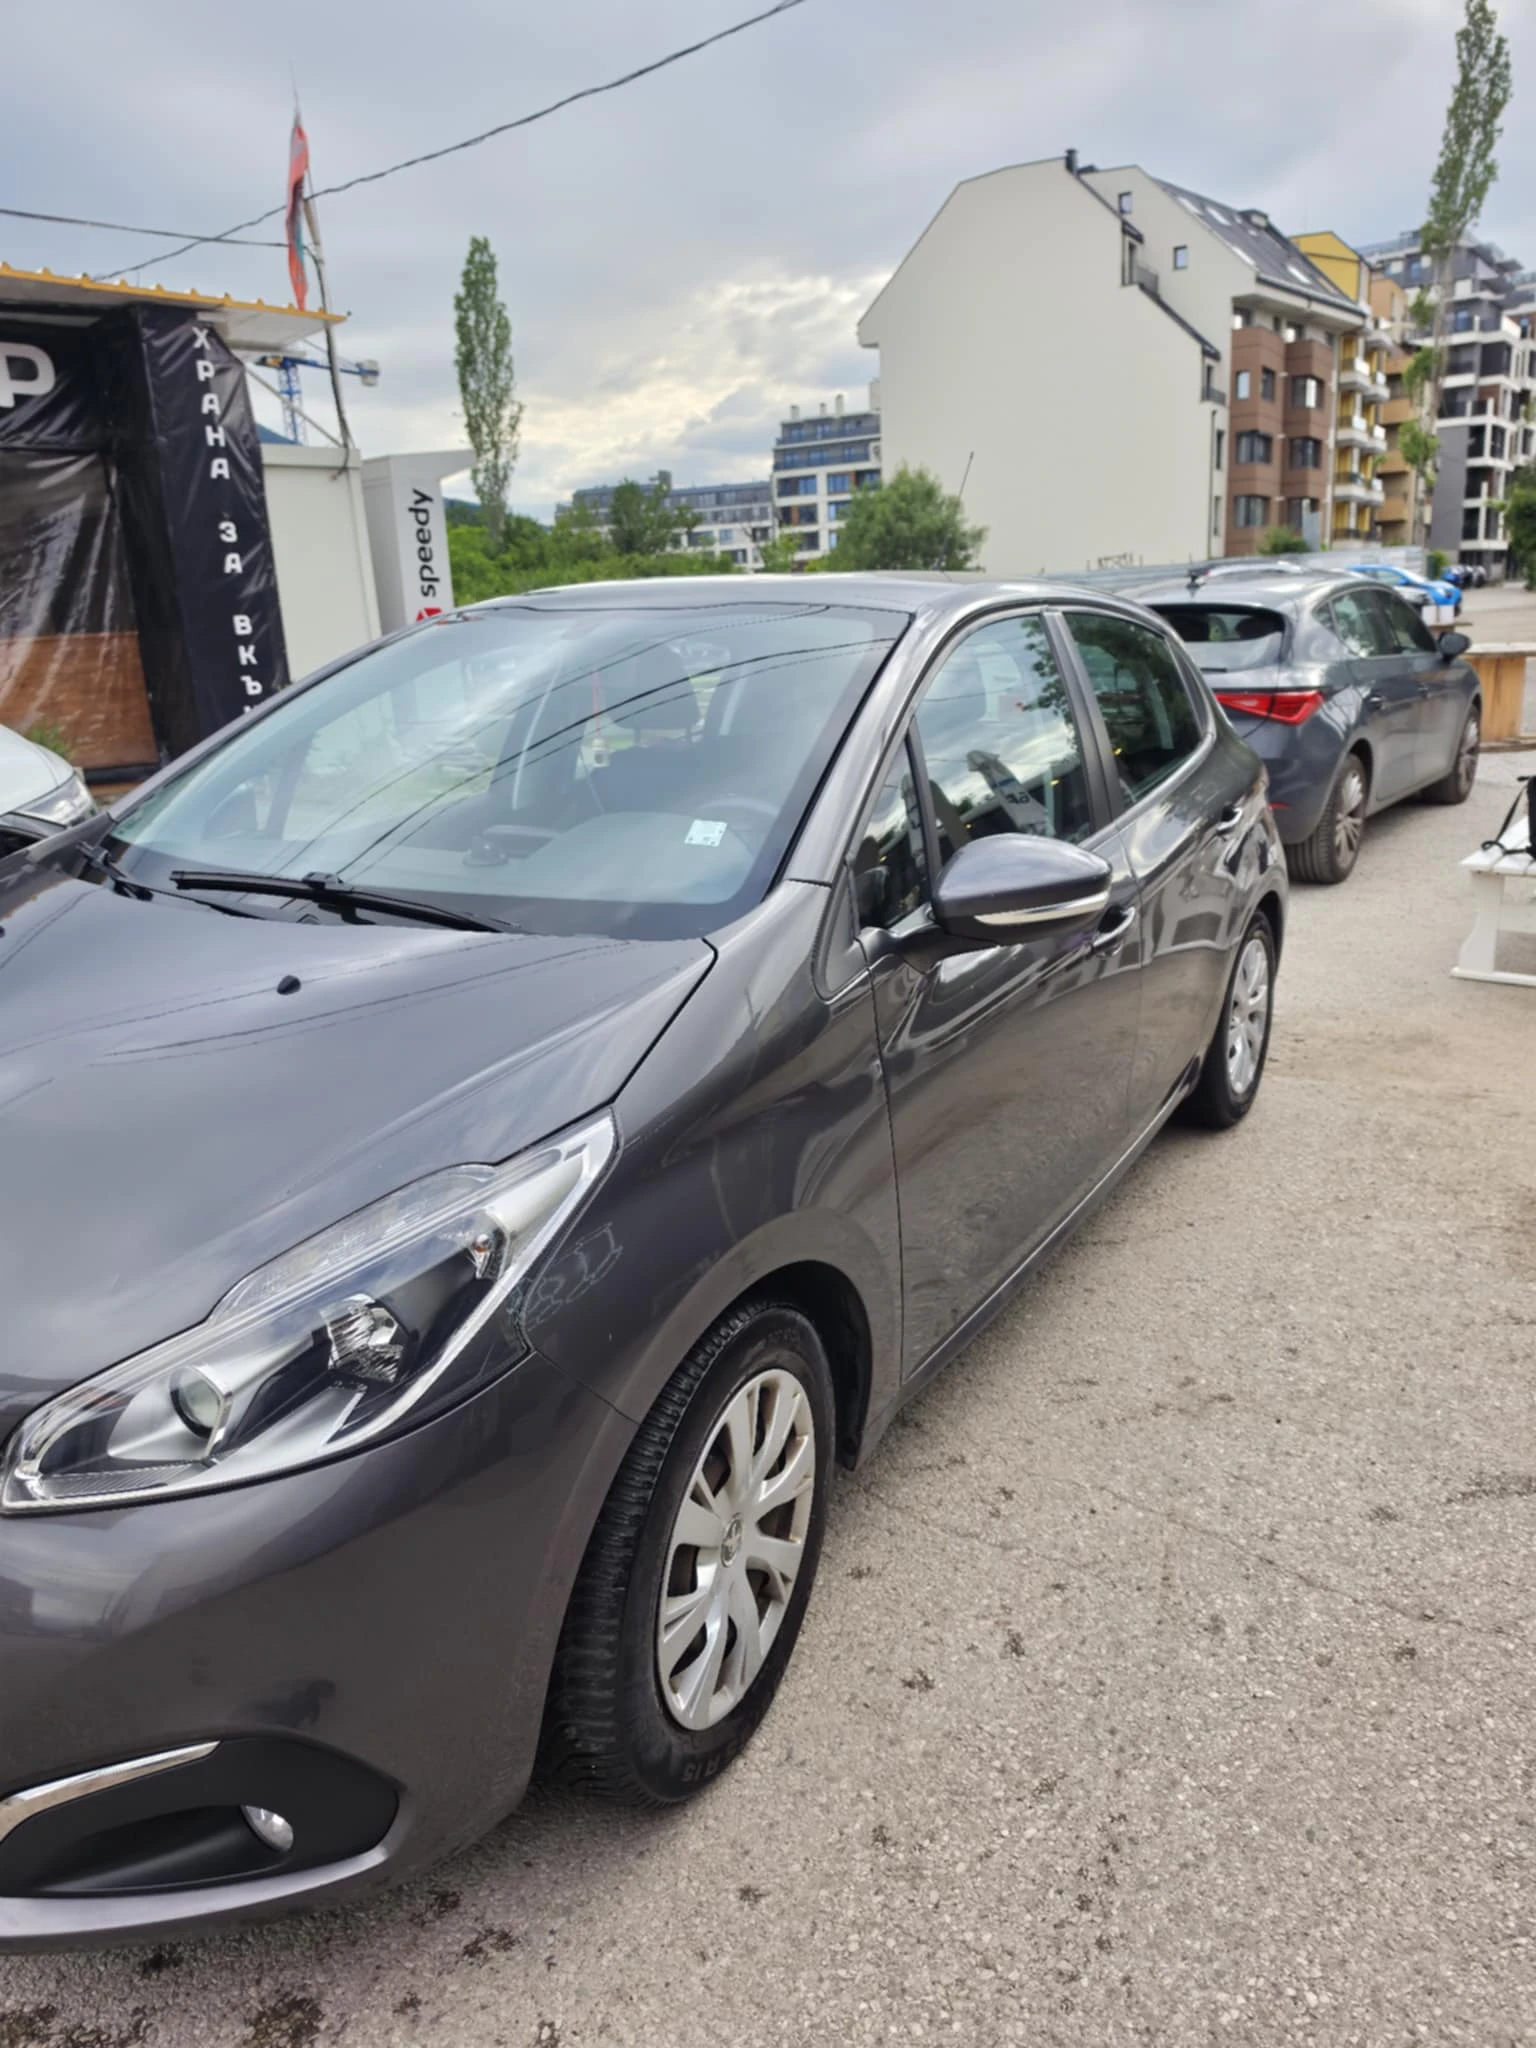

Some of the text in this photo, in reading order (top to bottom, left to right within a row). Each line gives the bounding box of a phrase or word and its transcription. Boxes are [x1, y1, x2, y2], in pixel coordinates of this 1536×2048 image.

[192, 326, 263, 714] ХРАНА ЗА ВКЪ
[408, 487, 441, 598] speedy
